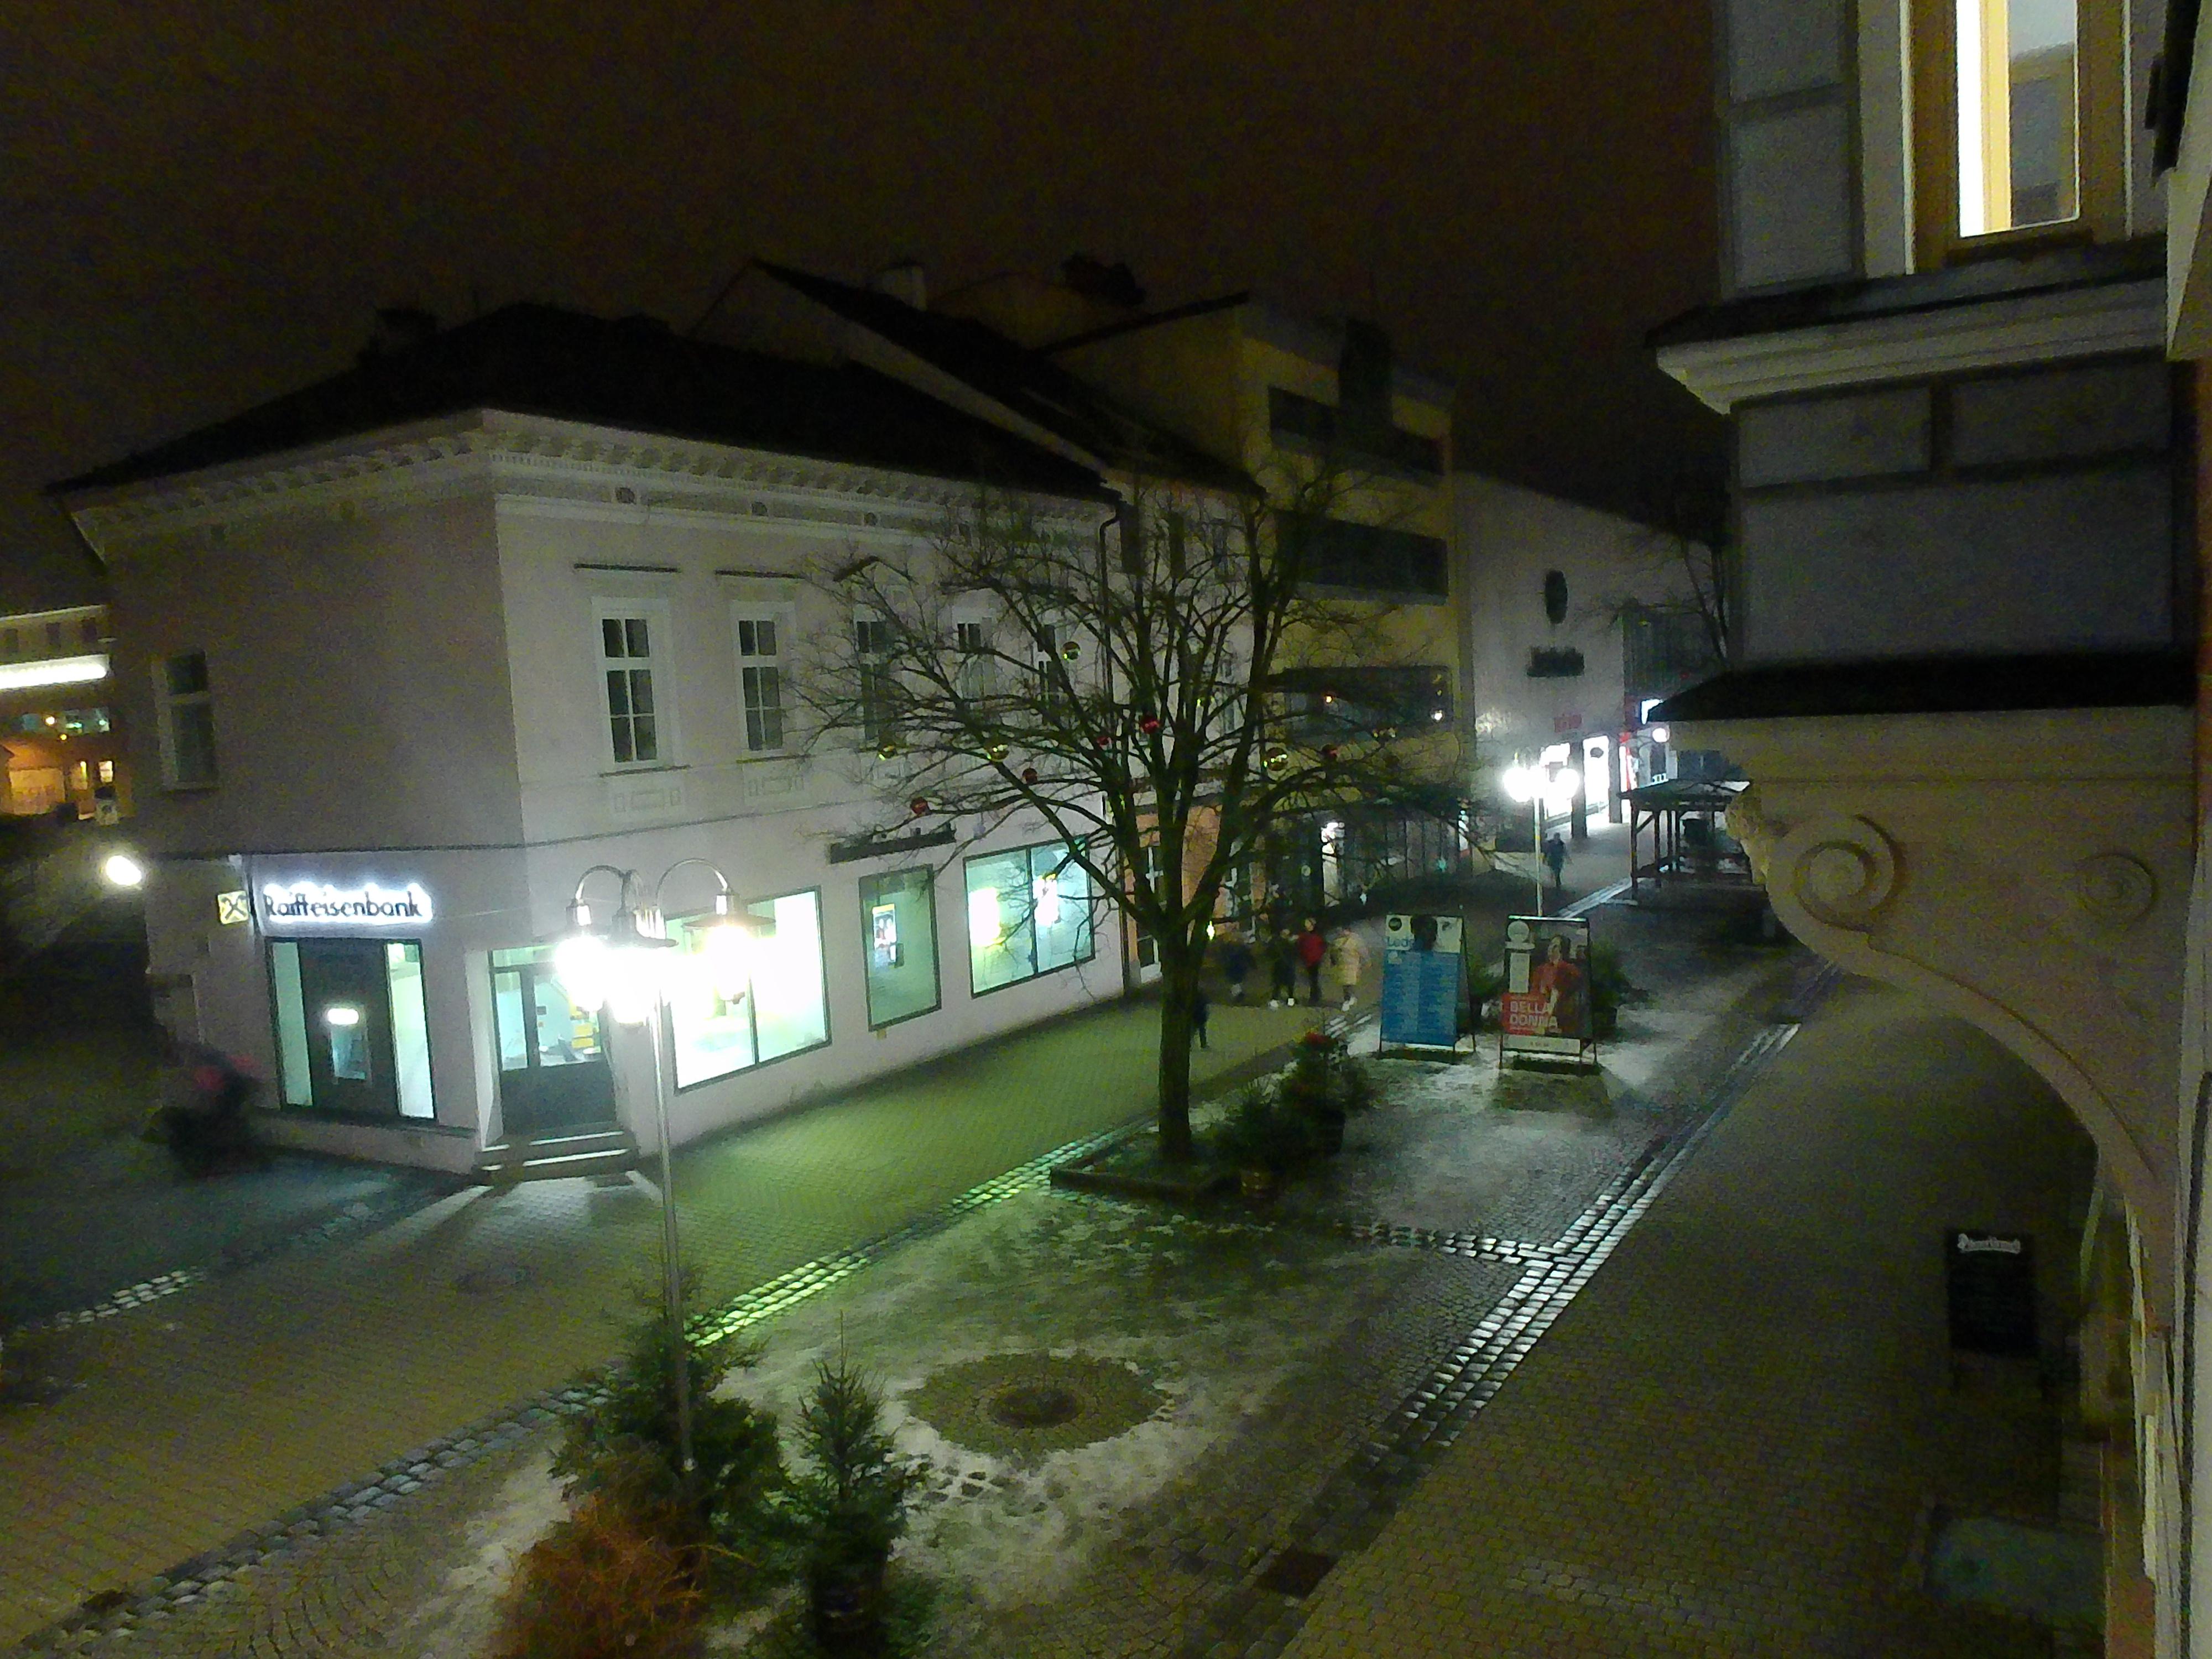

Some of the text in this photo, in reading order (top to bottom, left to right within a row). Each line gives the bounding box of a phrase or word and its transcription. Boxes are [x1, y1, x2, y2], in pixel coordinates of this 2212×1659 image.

[264, 890, 422, 917] Raiffeisenbank
[1510, 1000, 1555, 1015] BELLA
[1509, 1014, 1559, 1029] DONNA
